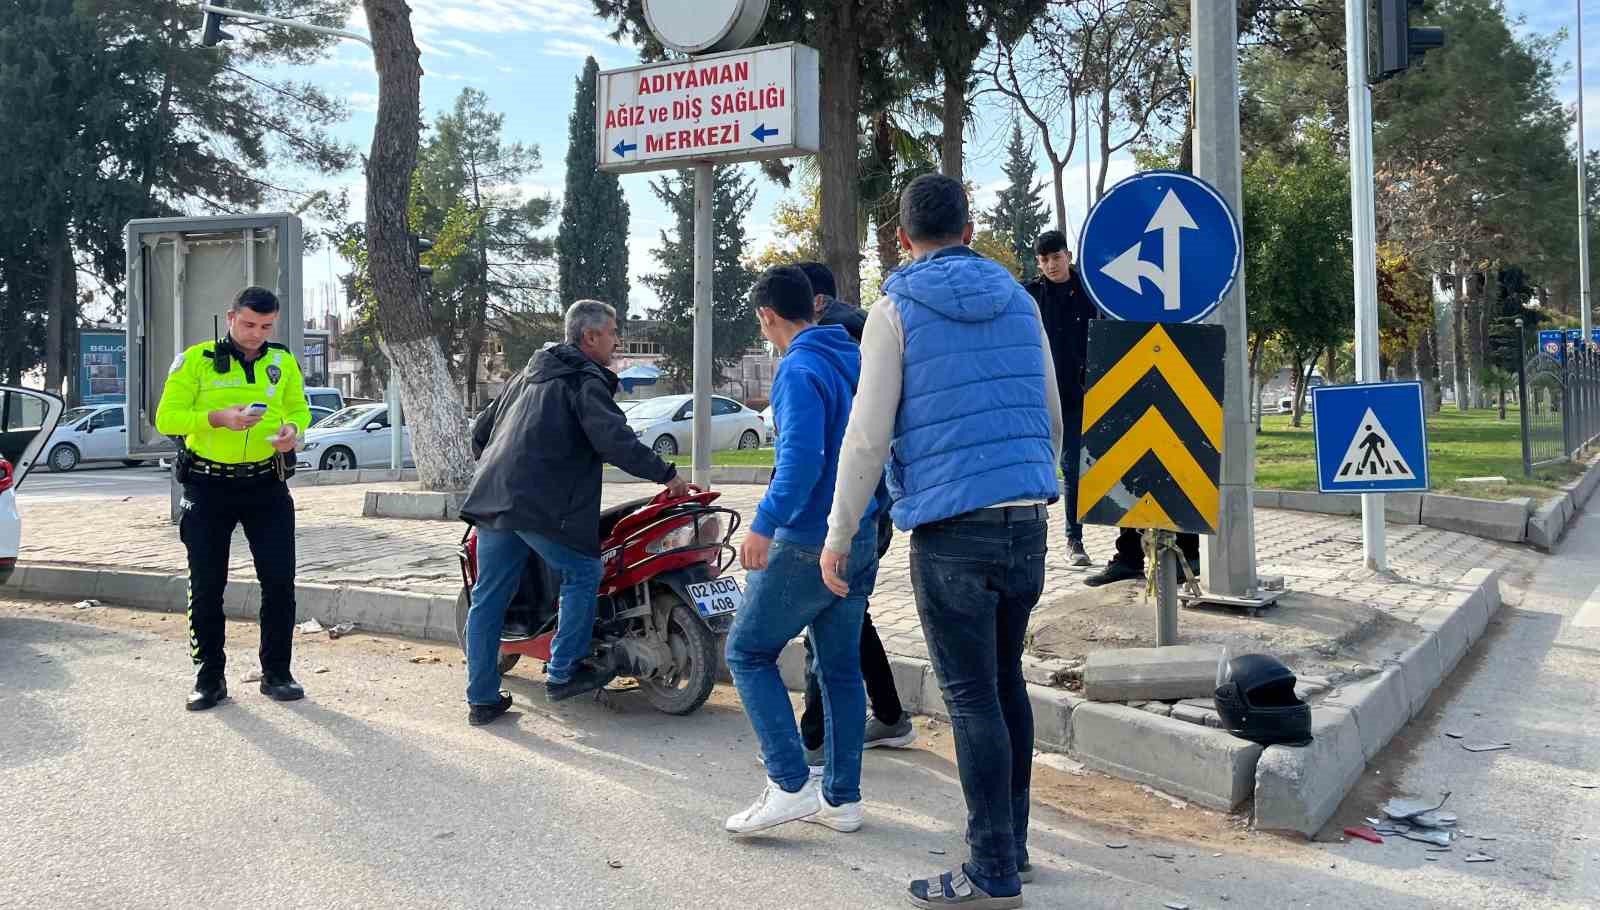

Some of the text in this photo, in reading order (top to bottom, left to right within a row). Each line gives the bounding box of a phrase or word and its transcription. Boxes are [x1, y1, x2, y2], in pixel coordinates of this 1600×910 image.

[638, 61, 748, 95] ADIYAMAN
[605, 83, 785, 129] AĞIZ ve DİŞ SAĞLIĞI
[645, 120, 740, 153] MERKEZİ
[691, 585, 710, 599] 02
[711, 596, 735, 611] 408
